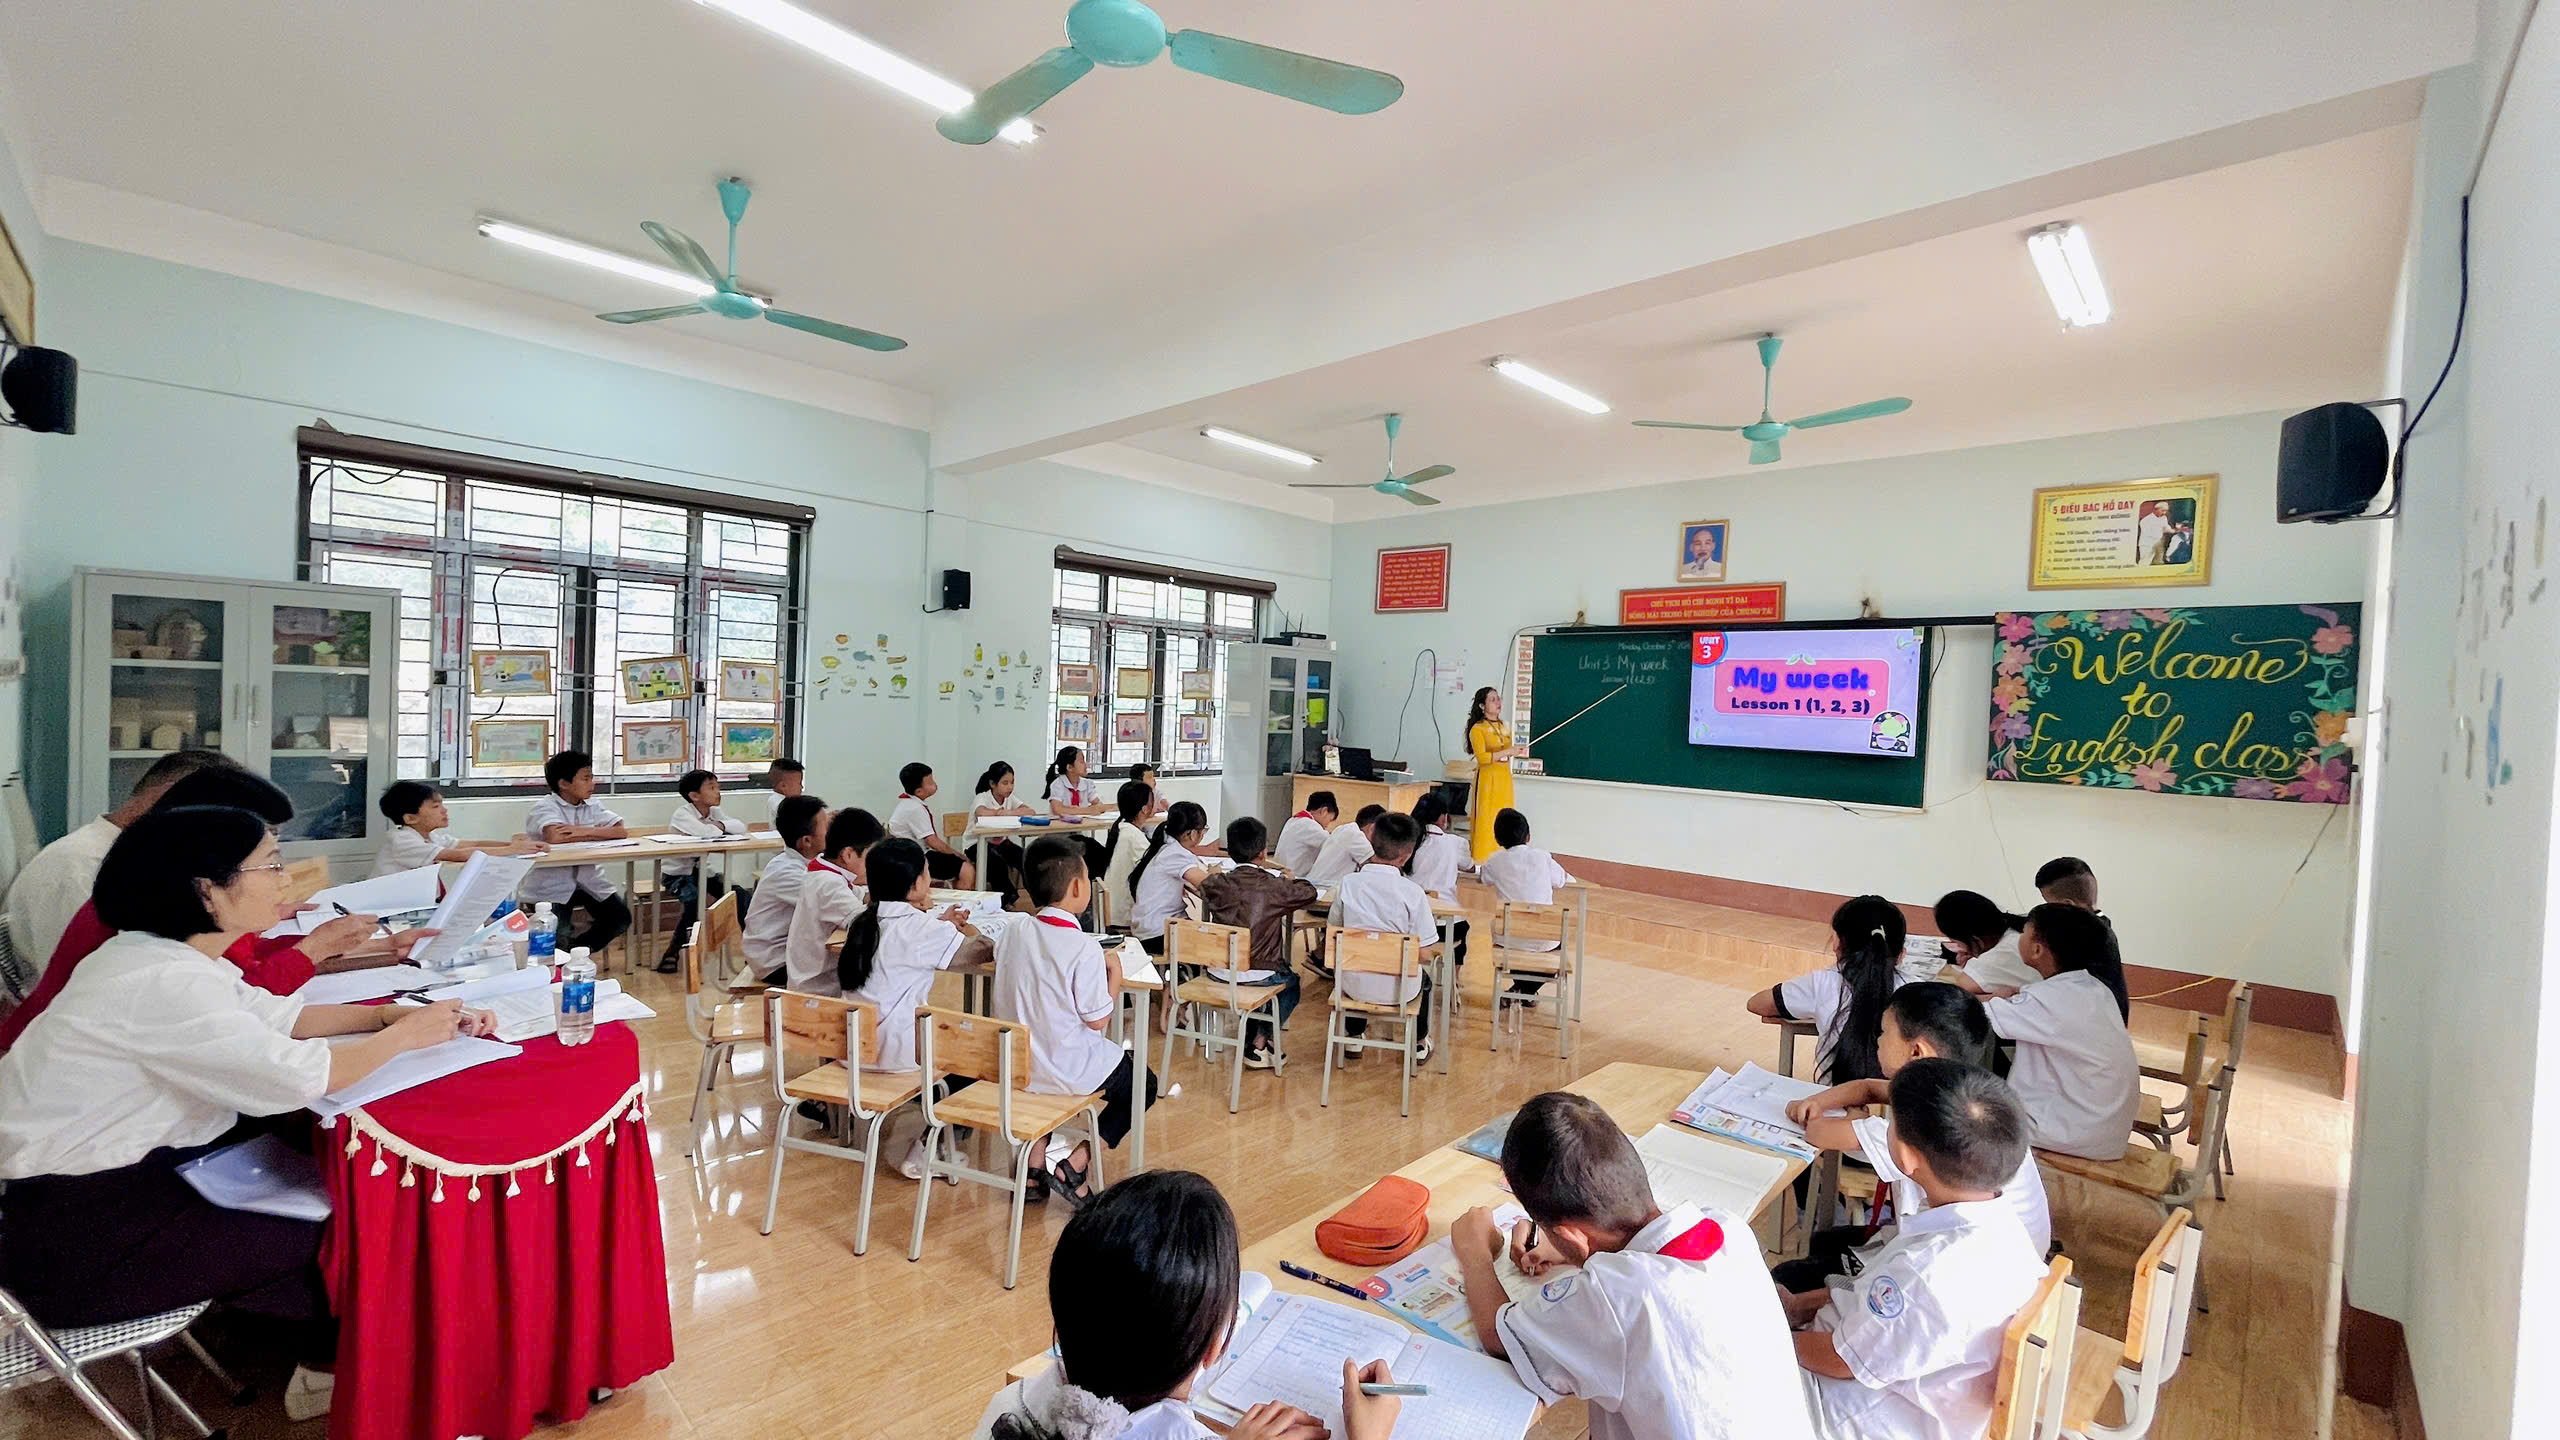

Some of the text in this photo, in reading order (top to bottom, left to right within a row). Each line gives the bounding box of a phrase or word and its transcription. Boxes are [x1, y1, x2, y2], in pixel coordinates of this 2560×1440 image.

[2052, 505, 2059, 515] 5
[1699, 636, 1721, 645] UNIT
[1702, 645, 1712, 659] 3
[2036, 620, 2309, 684] Welcome
[1578, 655, 1601, 670] Unit
[1617, 655, 1636, 675] My
[1640, 657, 1670, 671] week
[1733, 666, 1870, 694] My week
[1731, 697, 1871, 715] Lesson 1 (1, 2, 3)
[2120, 681, 2172, 718] to
[2012, 713, 2185, 776] English
